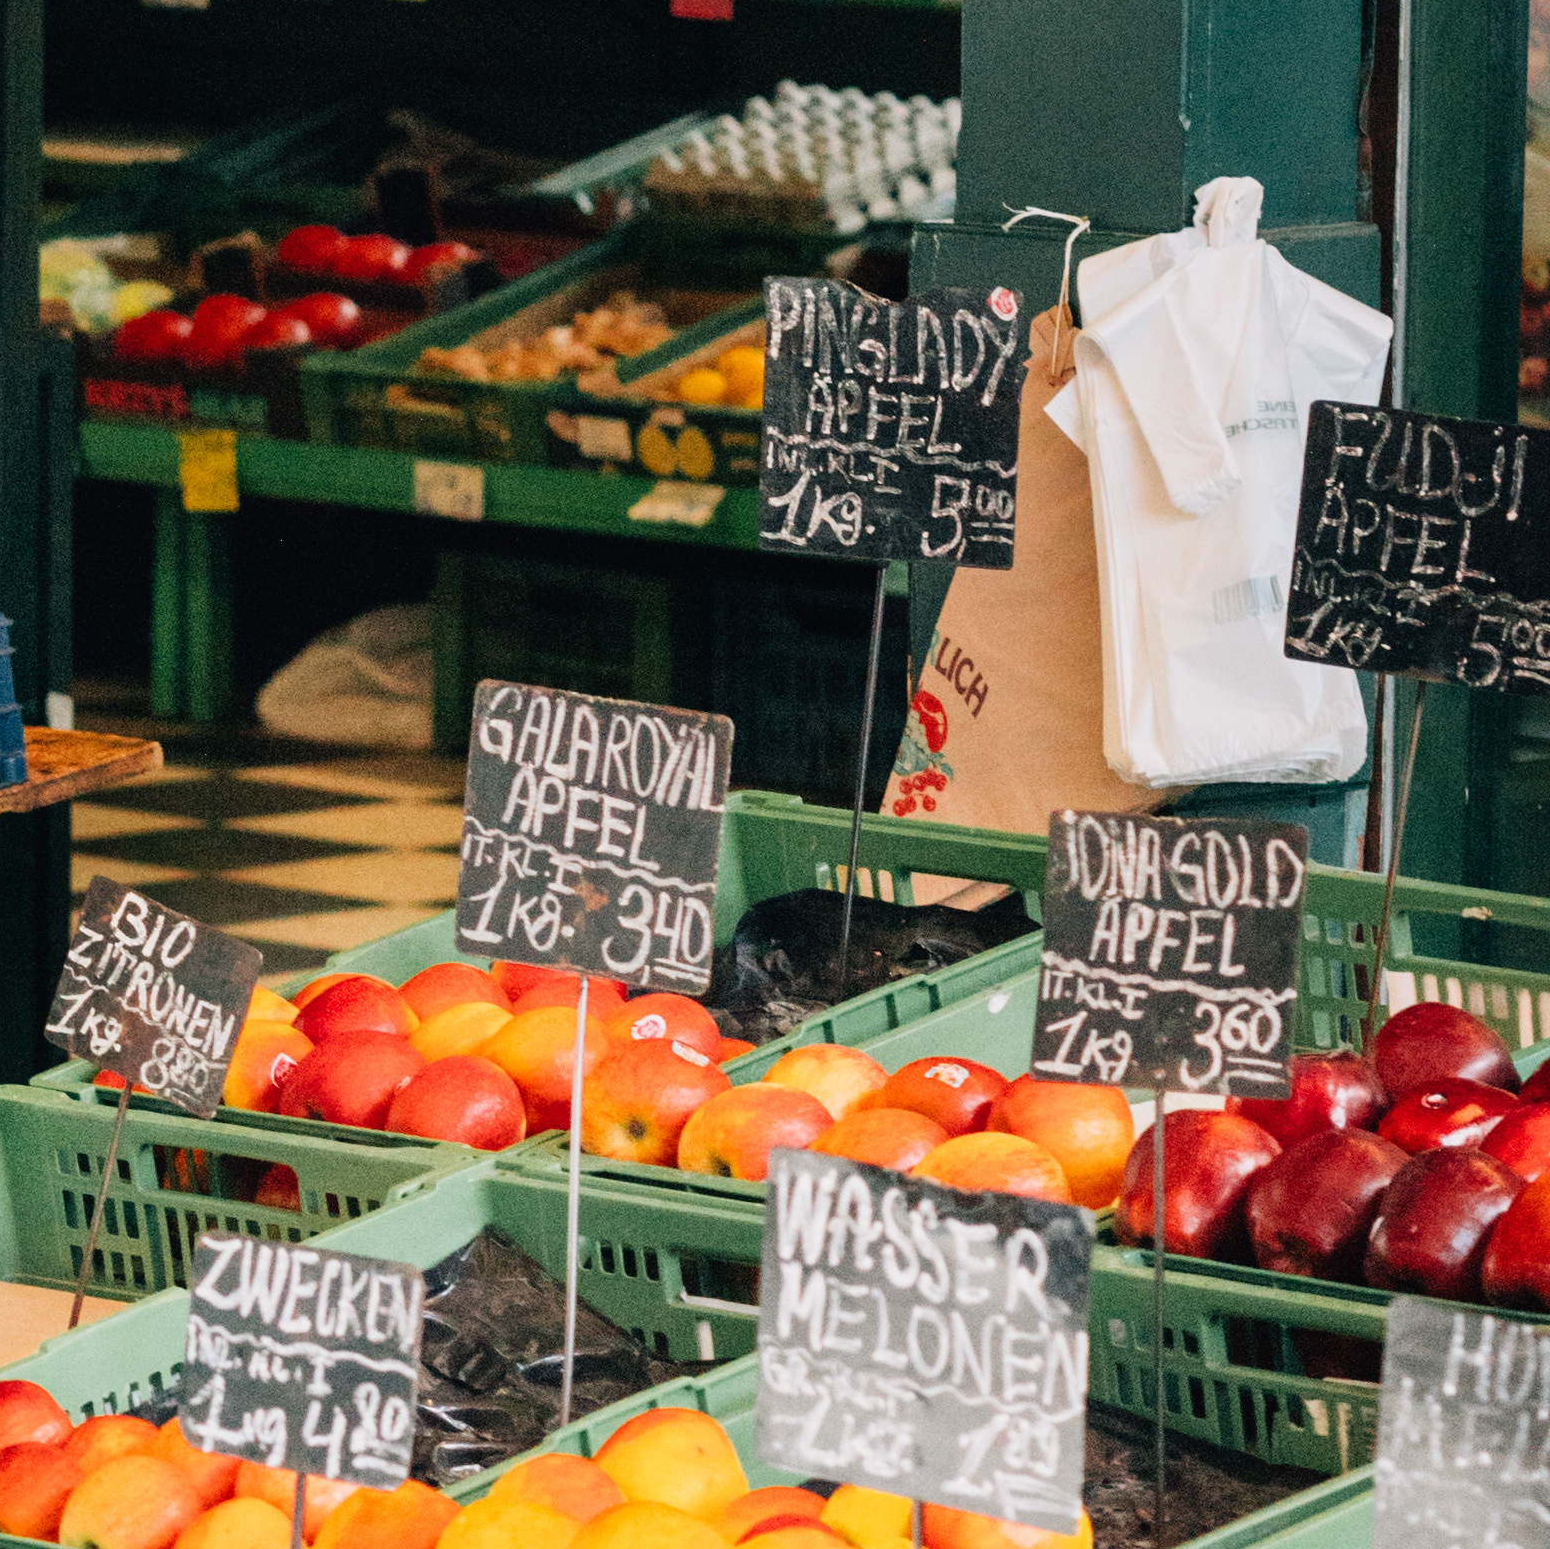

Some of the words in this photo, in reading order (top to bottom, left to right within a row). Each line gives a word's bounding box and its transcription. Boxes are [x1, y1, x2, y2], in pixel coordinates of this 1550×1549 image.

[71, 930, 237, 1063] ZITRONEN
[112, 889, 196, 970] BIO
[777, 1162, 1048, 1316] WASSER
[775, 1262, 1089, 1405] MELONEN
